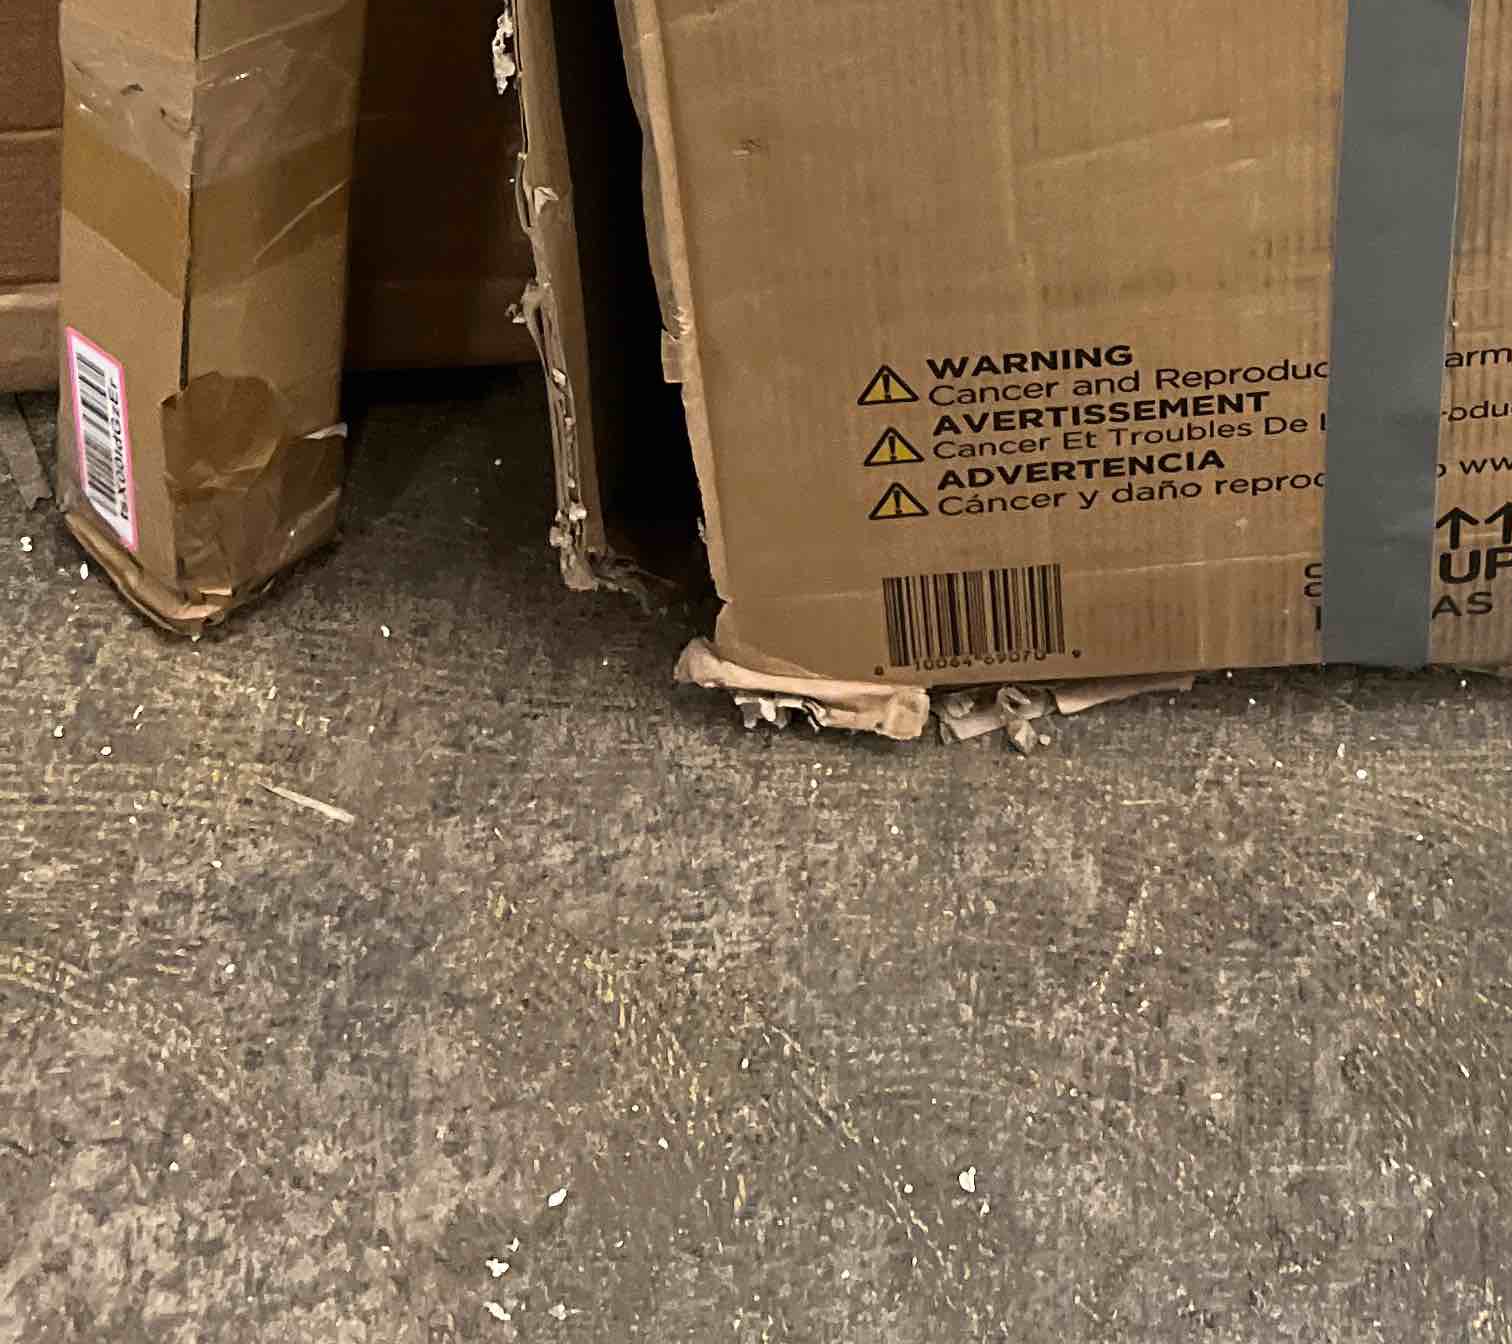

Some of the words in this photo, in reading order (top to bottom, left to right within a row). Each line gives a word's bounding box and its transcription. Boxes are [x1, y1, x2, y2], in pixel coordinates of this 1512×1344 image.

[926, 345, 1133, 380] WARNING
[929, 380, 1059, 407] Cancer
[1072, 371, 1141, 397] and
[933, 391, 1271, 436] AVERTISSEMENT
[933, 433, 1052, 461] Cancer
[1064, 430, 1098, 450] Et
[1107, 417, 1253, 448] Troubles
[1264, 415, 1310, 436] De
[937, 449, 1226, 490] ADVERTENCIA
[938, 488, 1066, 516] Cáncer
[1076, 489, 1099, 510] y
[1111, 474, 1202, 504] daño
[1431, 591, 1493, 619] AS
[914, 657, 973, 672] 10064
